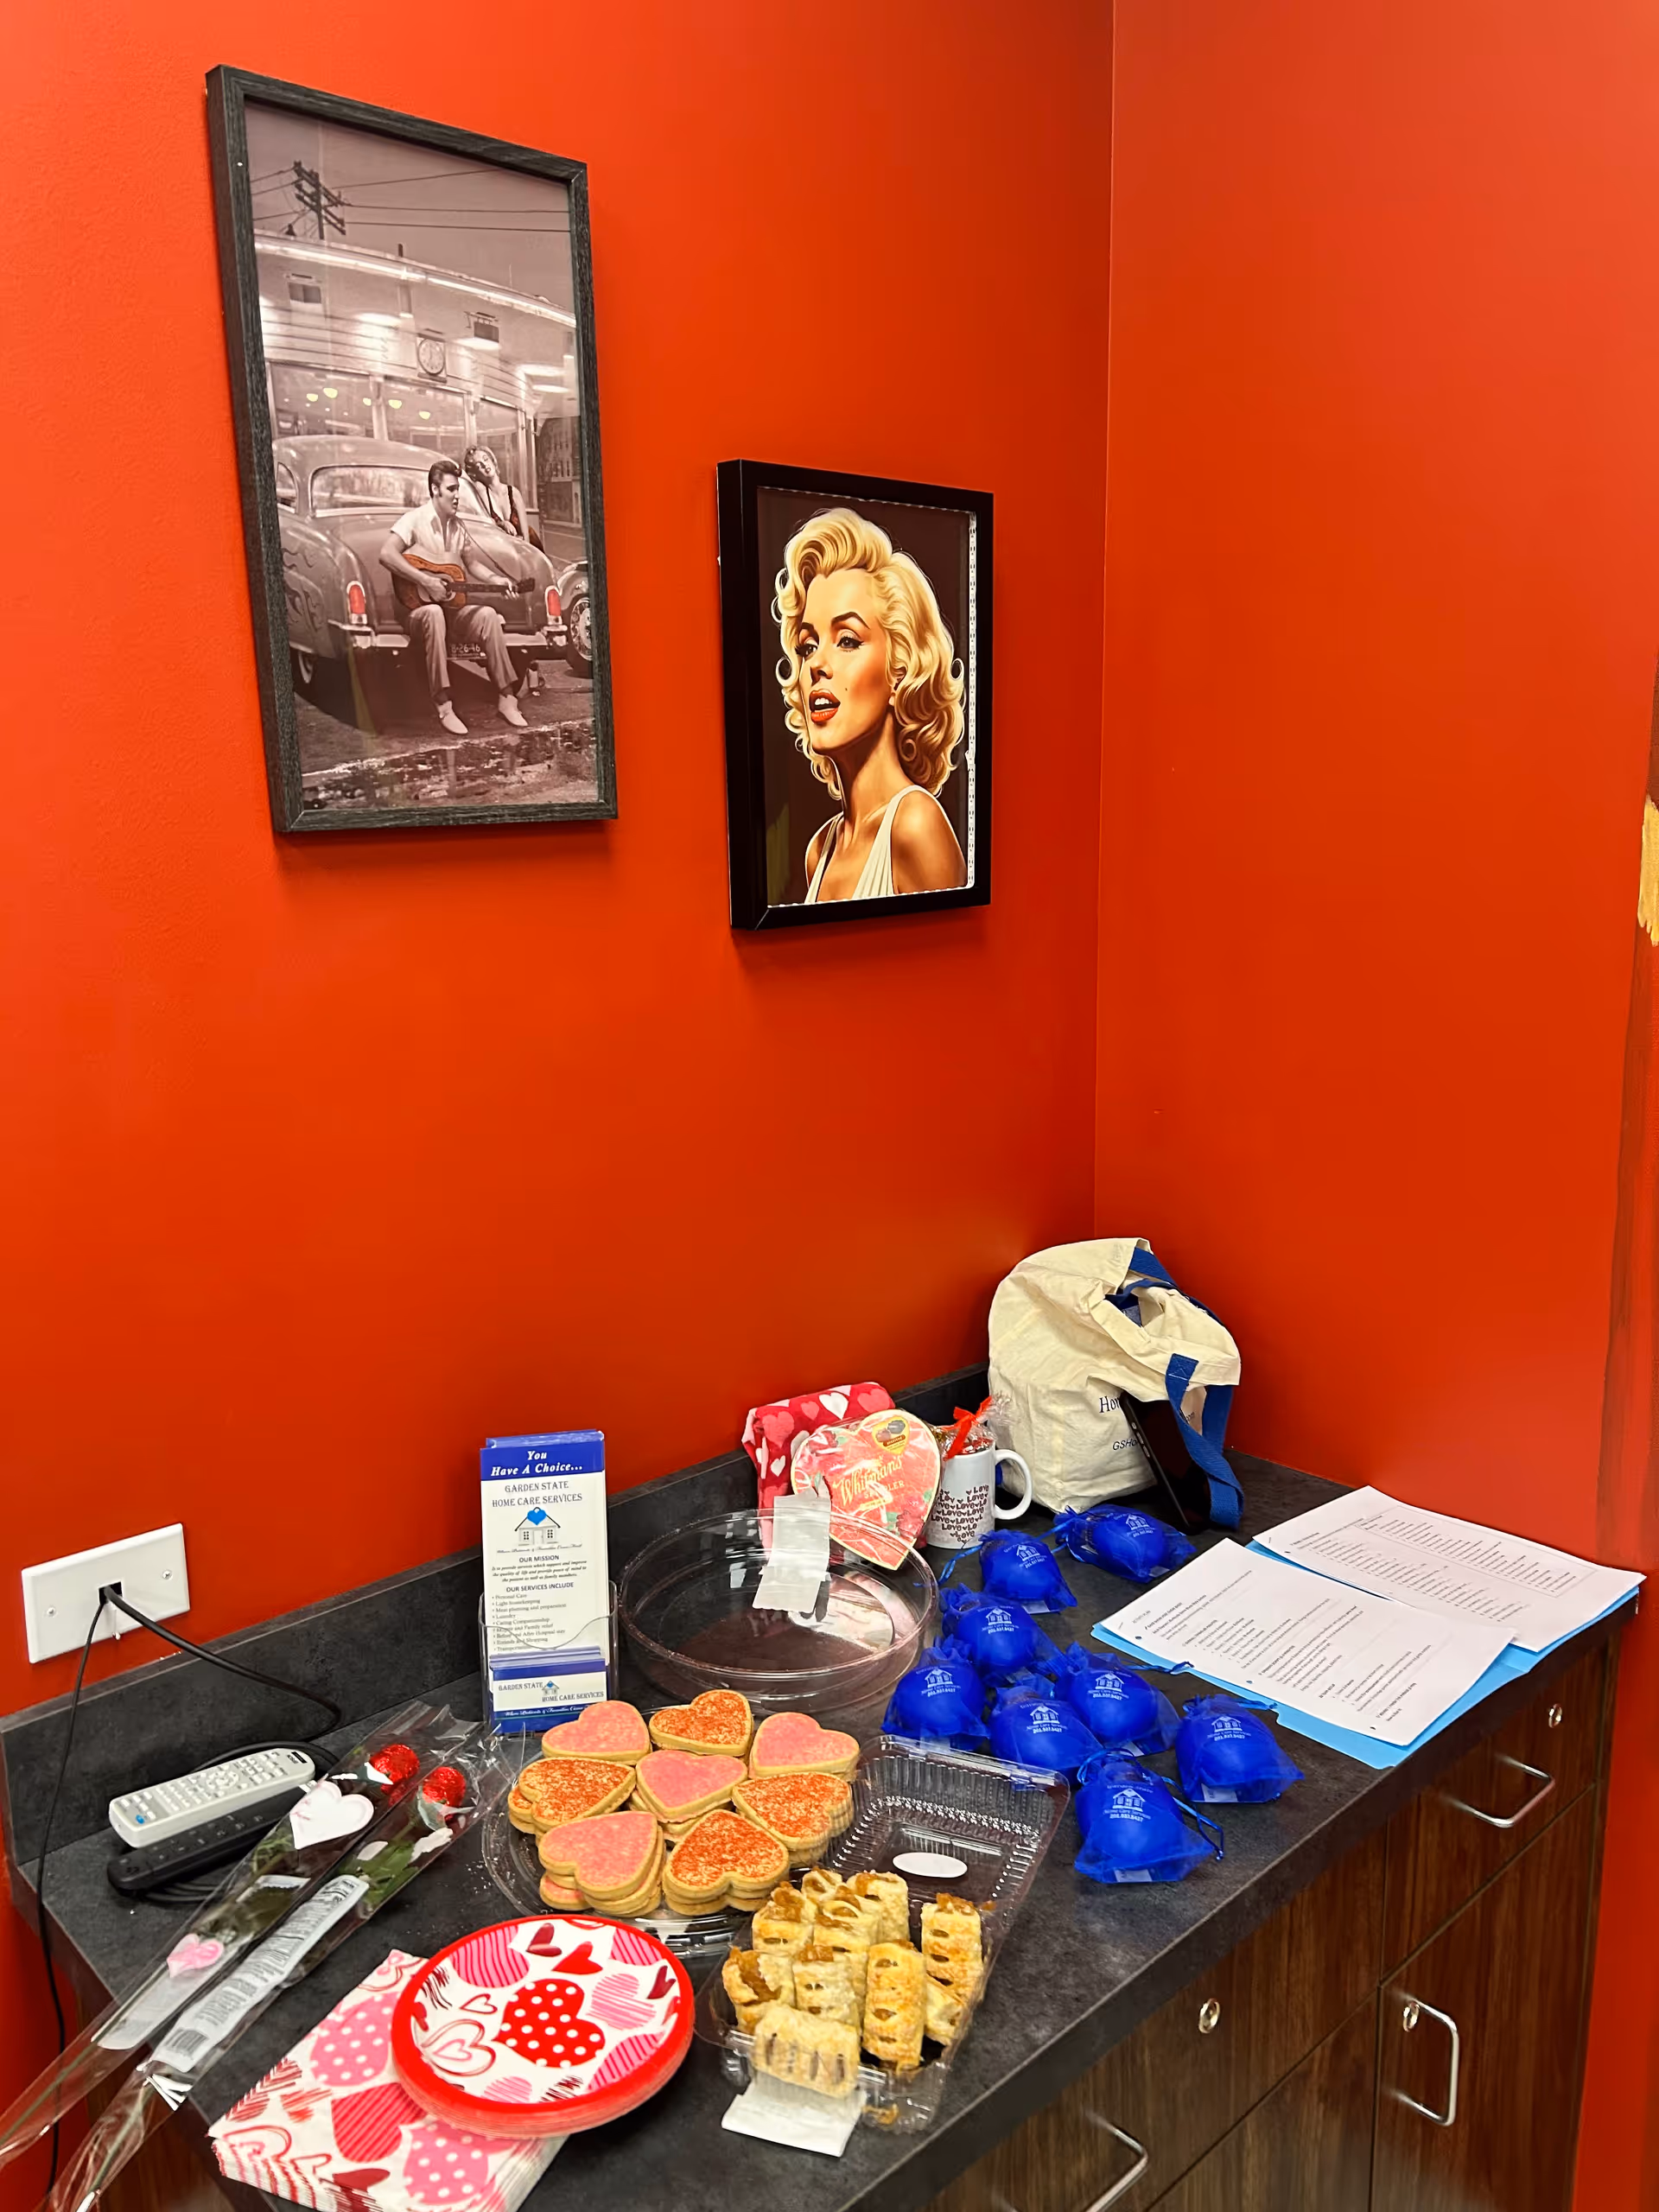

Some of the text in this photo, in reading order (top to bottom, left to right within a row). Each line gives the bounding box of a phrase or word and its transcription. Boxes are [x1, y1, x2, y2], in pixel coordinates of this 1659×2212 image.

[527, 1451, 547, 1460] You
[491, 1463, 582, 1476] Have A Choice...
[505, 1480, 569, 1493] GARDEN STATE
[832, 1455, 903, 1506] Whitman's
[492, 1493, 583, 1507] HOME CARE SERVICES
[576, 1691, 604, 1700] SERVICES
